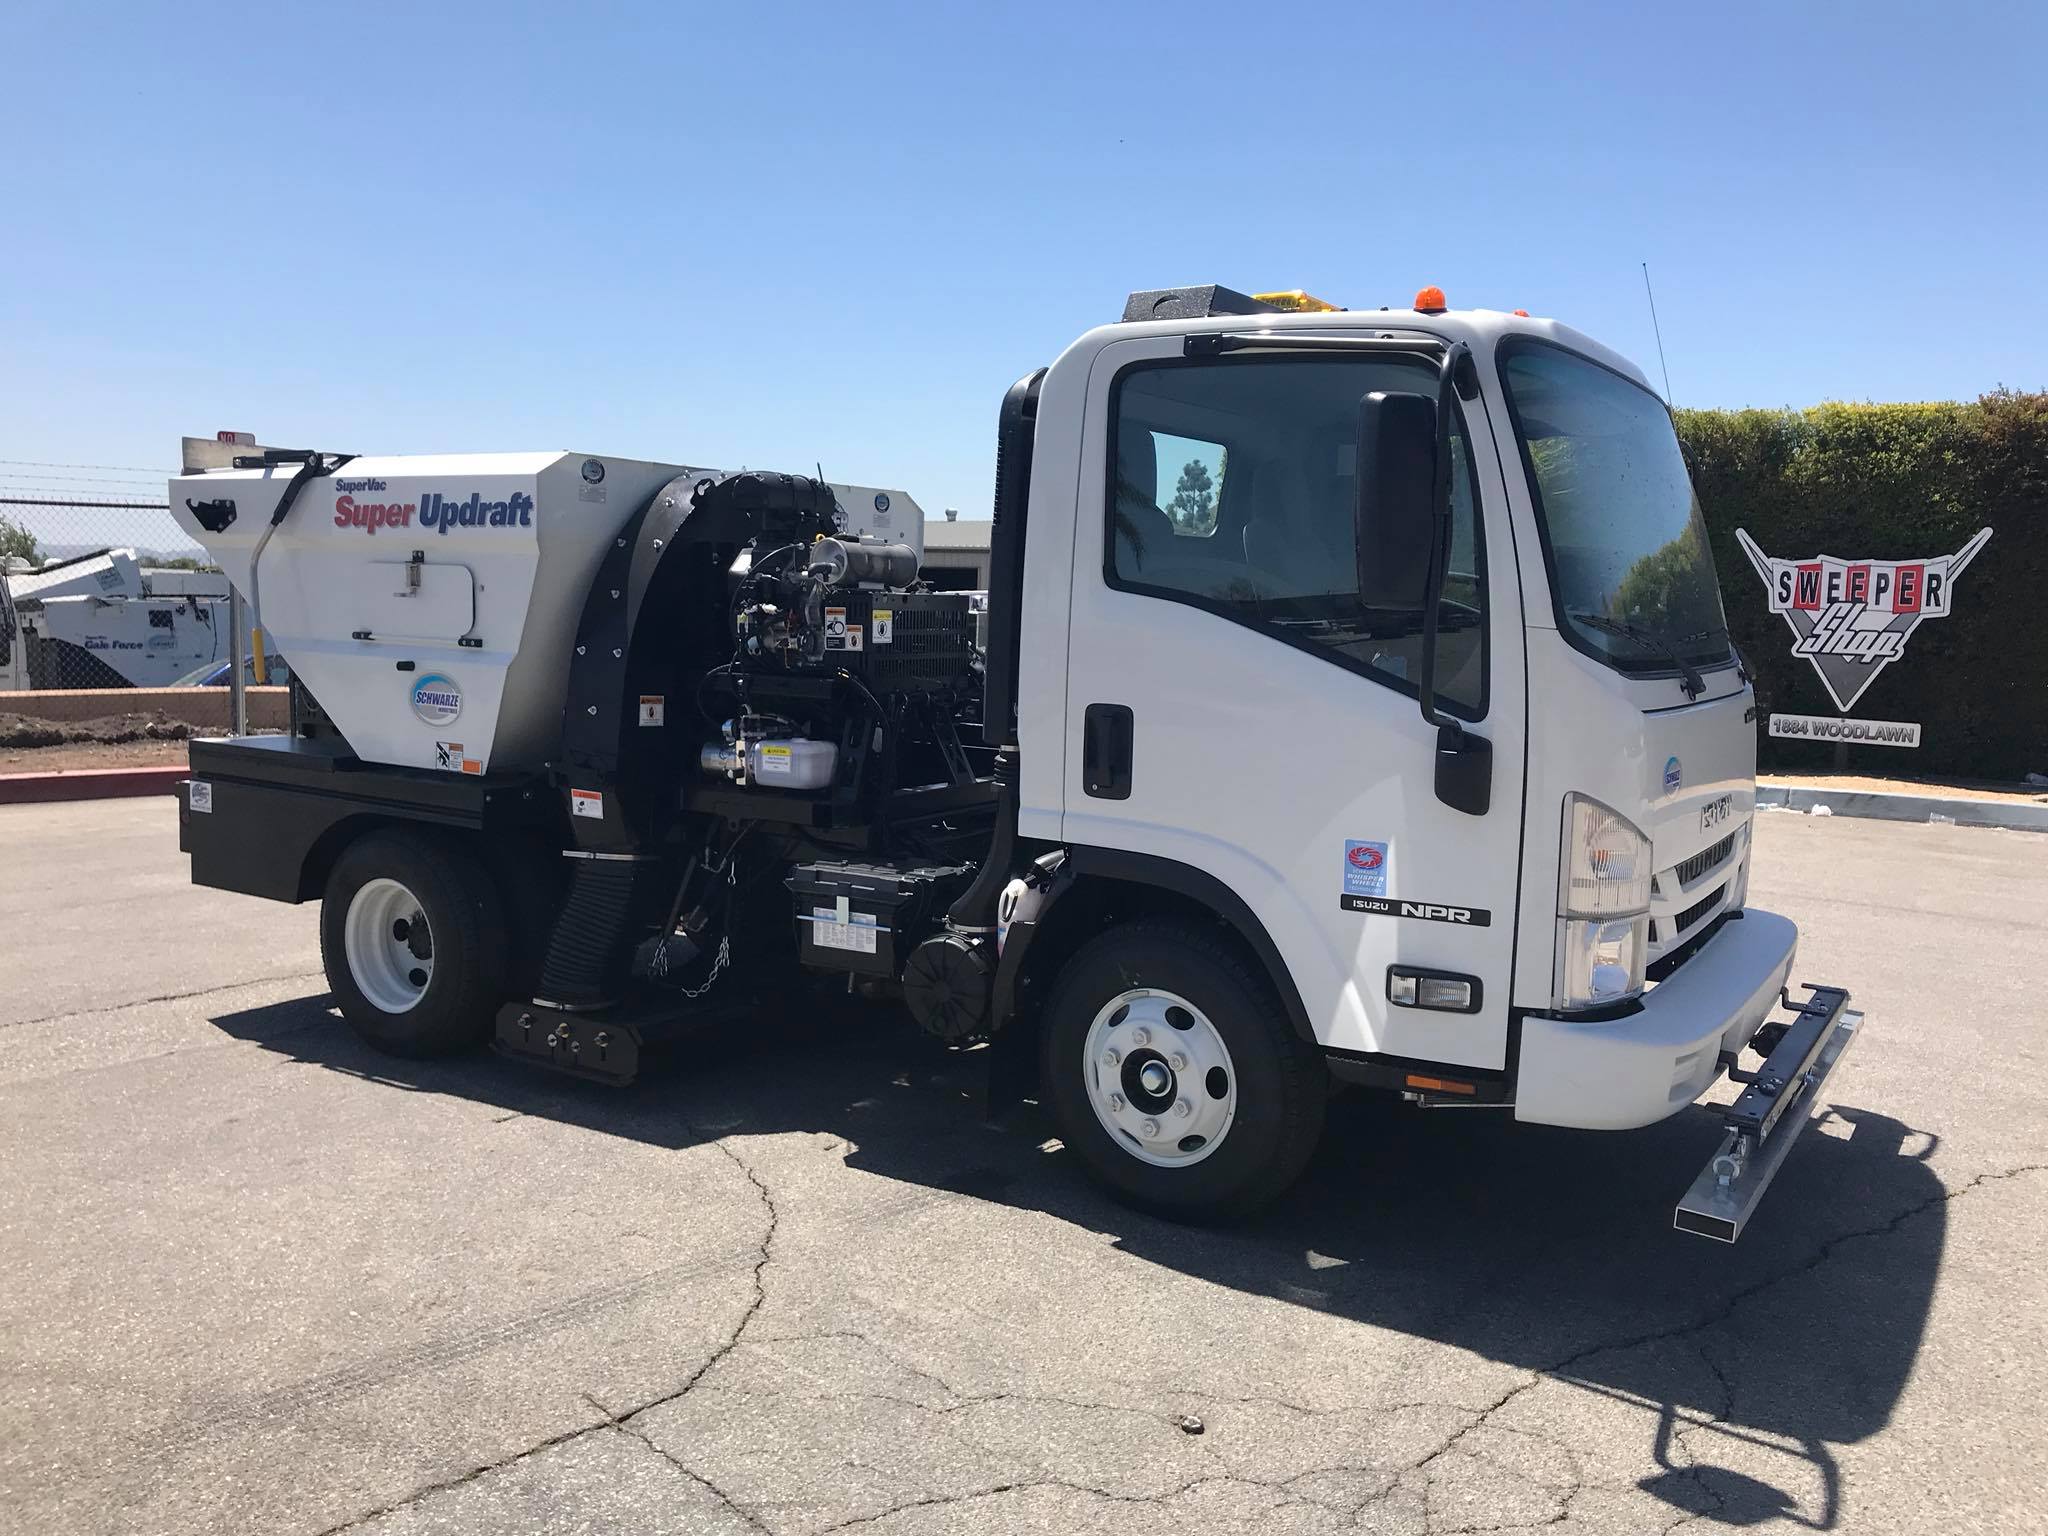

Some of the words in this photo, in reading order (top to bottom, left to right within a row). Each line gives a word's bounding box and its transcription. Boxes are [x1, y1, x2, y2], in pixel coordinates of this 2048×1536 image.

[335, 478, 387, 494] SuperVac
[334, 495, 415, 535] Super
[419, 491, 534, 536] Updraft
[1778, 570, 1942, 607] SWEEPER
[1798, 601, 1903, 664] Shop
[84, 640, 110, 650] Gale
[112, 640, 144, 650] Force
[416, 691, 459, 707] SCHWARZE
[1773, 718, 1809, 735] 1884
[1811, 720, 1915, 743] WOODLAWN
[1347, 873, 1385, 883] WHISPER
[1352, 879, 1383, 888] WHEEL
[1353, 900, 1389, 911] ISUZU
[1401, 902, 1472, 924] NPR
